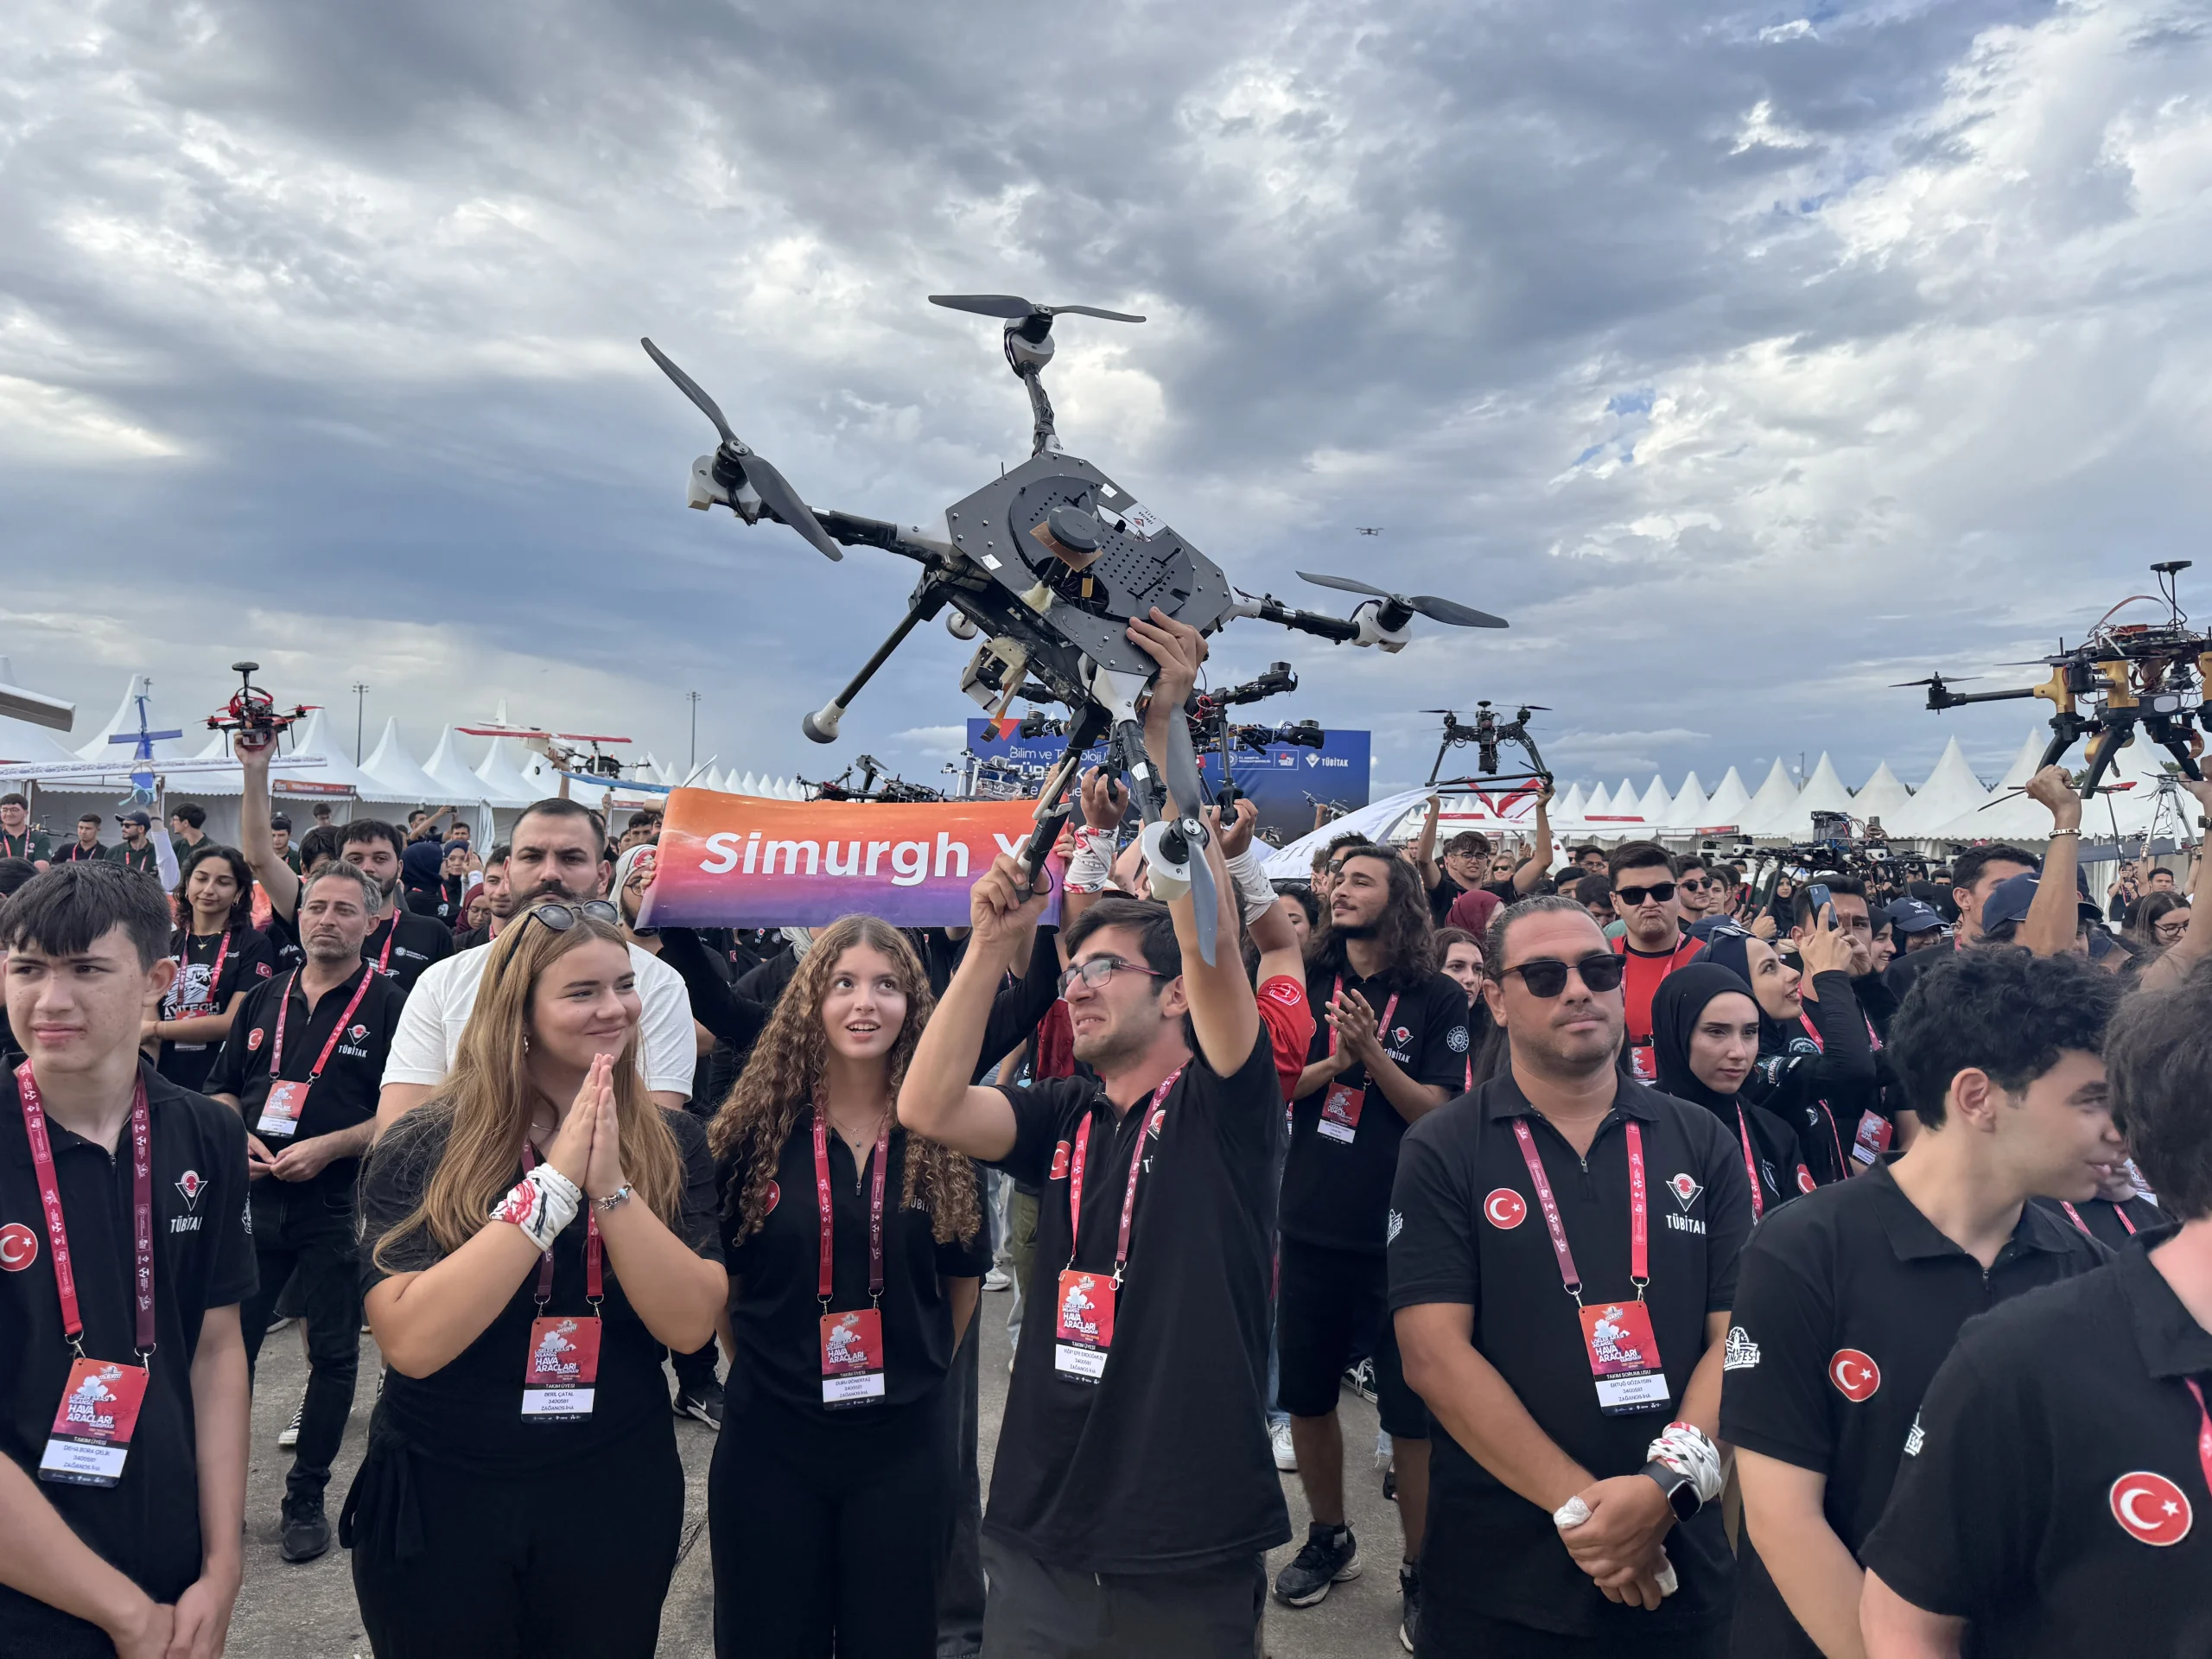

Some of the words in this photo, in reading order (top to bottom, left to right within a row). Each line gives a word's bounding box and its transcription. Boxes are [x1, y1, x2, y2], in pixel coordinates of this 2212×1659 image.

[1010, 747, 1036, 760] Bilim
[1039, 750, 1052, 760] ve
[1321, 757, 1348, 767] TÜBİTAK
[699, 830, 969, 887] Simurgh
[338, 1044, 368, 1058] TÜBİTAK
[1063, 1312, 1081, 1321] HAVA
[828, 1348, 849, 1357] HAVA
[1595, 1344, 1618, 1357] HAVA
[536, 1357, 559, 1365] HAVA
[67, 1404, 94, 1415] HAVA
